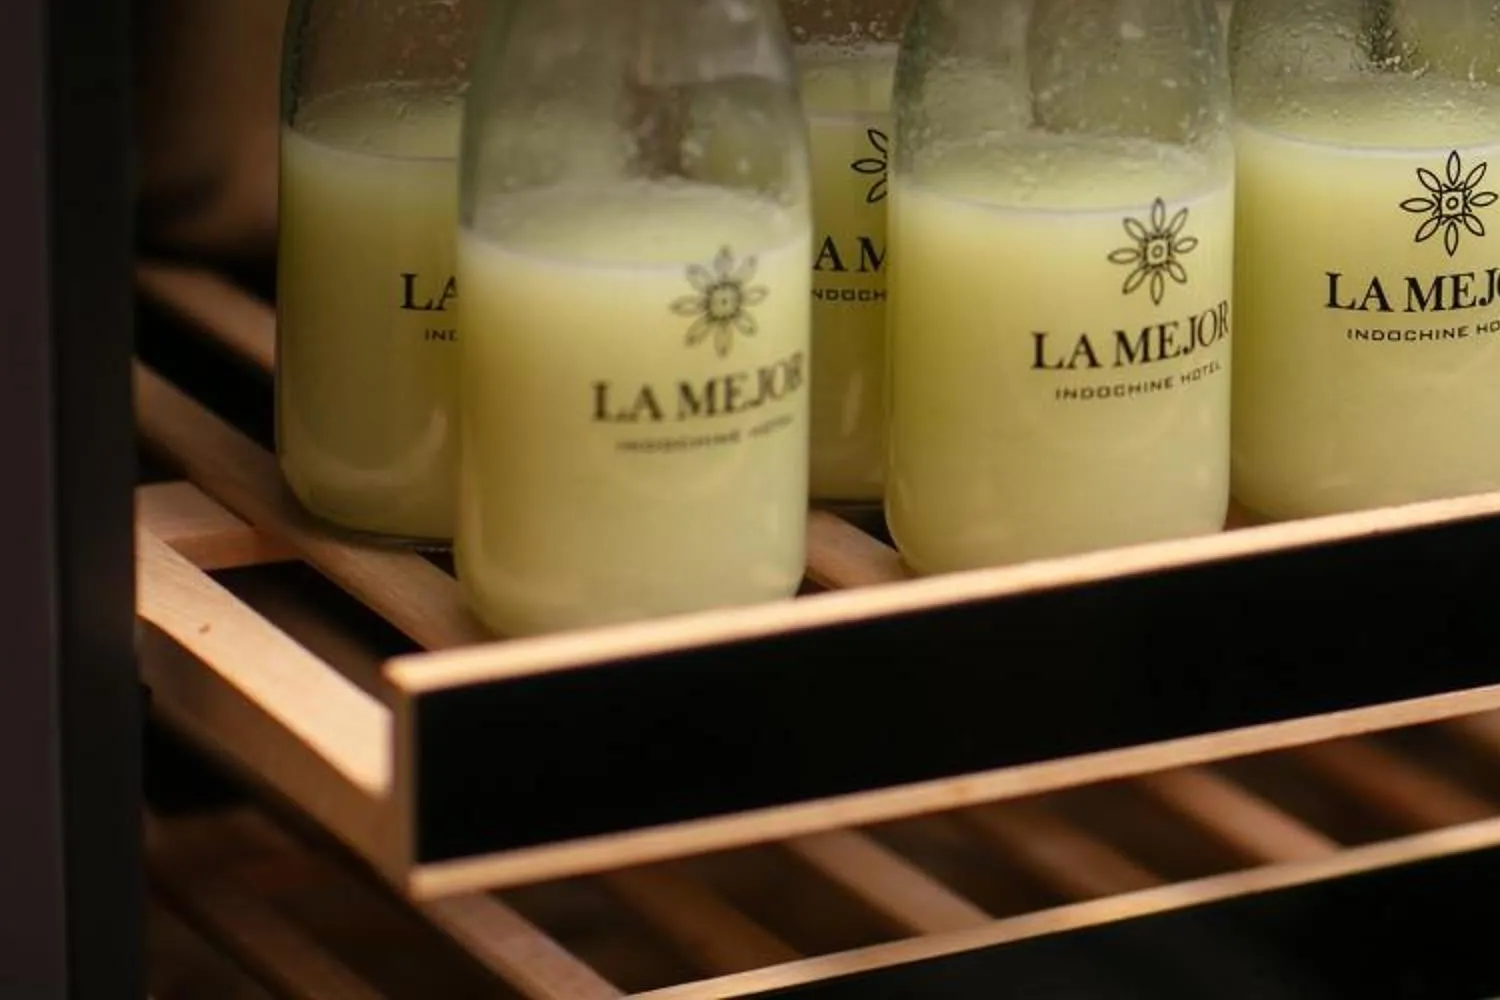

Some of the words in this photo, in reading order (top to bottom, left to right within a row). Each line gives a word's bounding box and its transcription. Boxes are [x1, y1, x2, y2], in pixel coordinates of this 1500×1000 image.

[812, 235, 848, 271] A
[1325, 271, 1394, 312] LA
[1030, 331, 1102, 370] LA
[1112, 300, 1229, 368] MEJOR
[1347, 326, 1468, 341] INDOCHINE
[1055, 376, 1174, 401] INDOCHINE
[1181, 361, 1222, 385] HOTEL
[592, 380, 663, 423] LA
